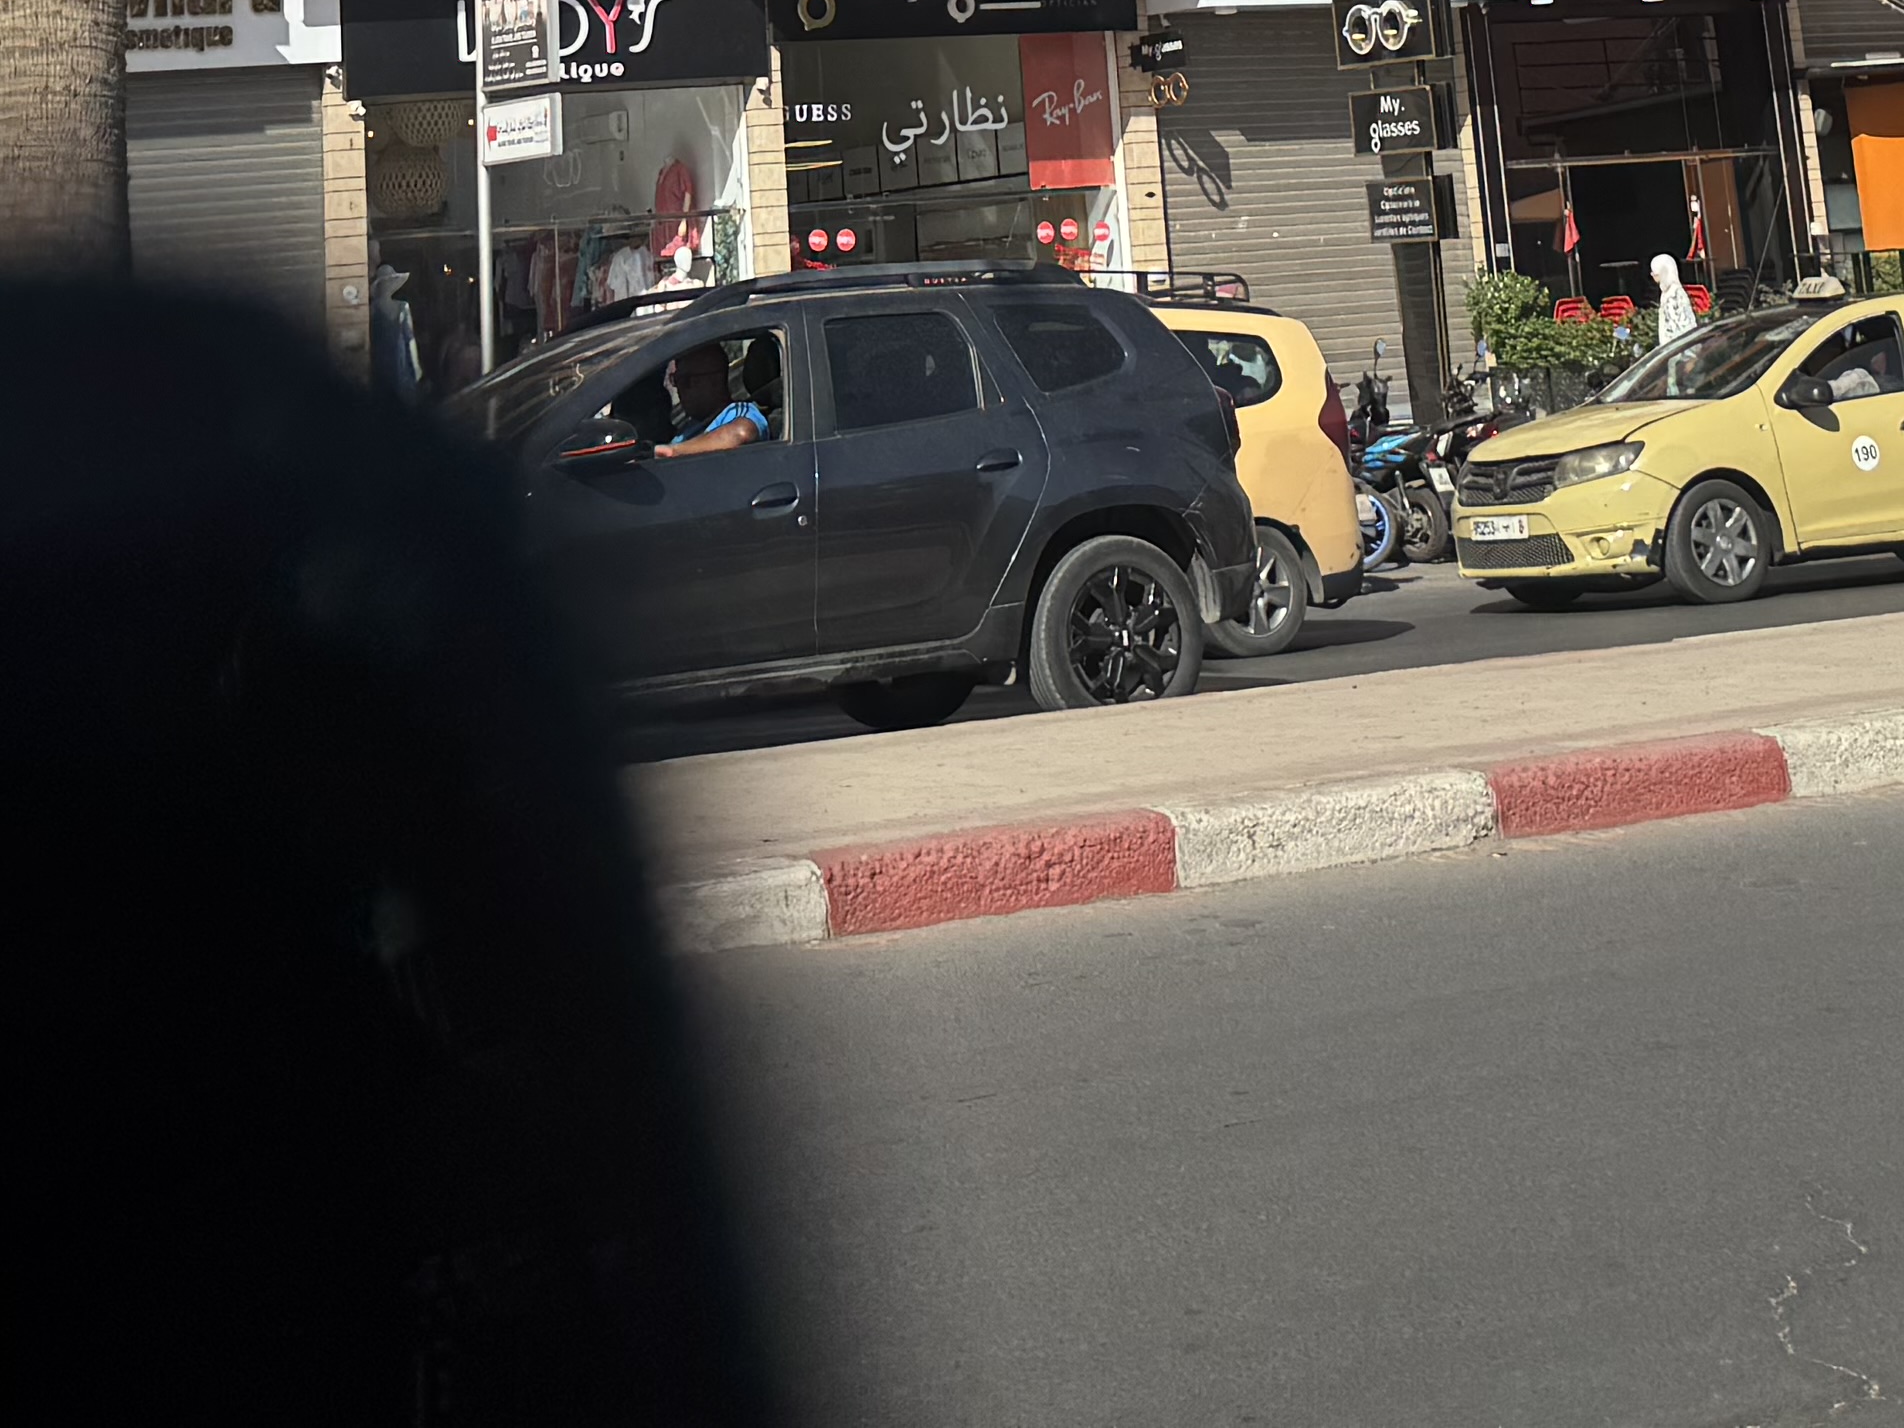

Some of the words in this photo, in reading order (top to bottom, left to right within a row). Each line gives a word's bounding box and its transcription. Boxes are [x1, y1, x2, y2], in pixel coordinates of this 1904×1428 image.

[1031, 78, 1104, 128] Ray-Ban
[882, 86, 1010, 165] نظارتي
[1370, 120, 1421, 154] glasses
[1854, 444, 1878, 463] 190
